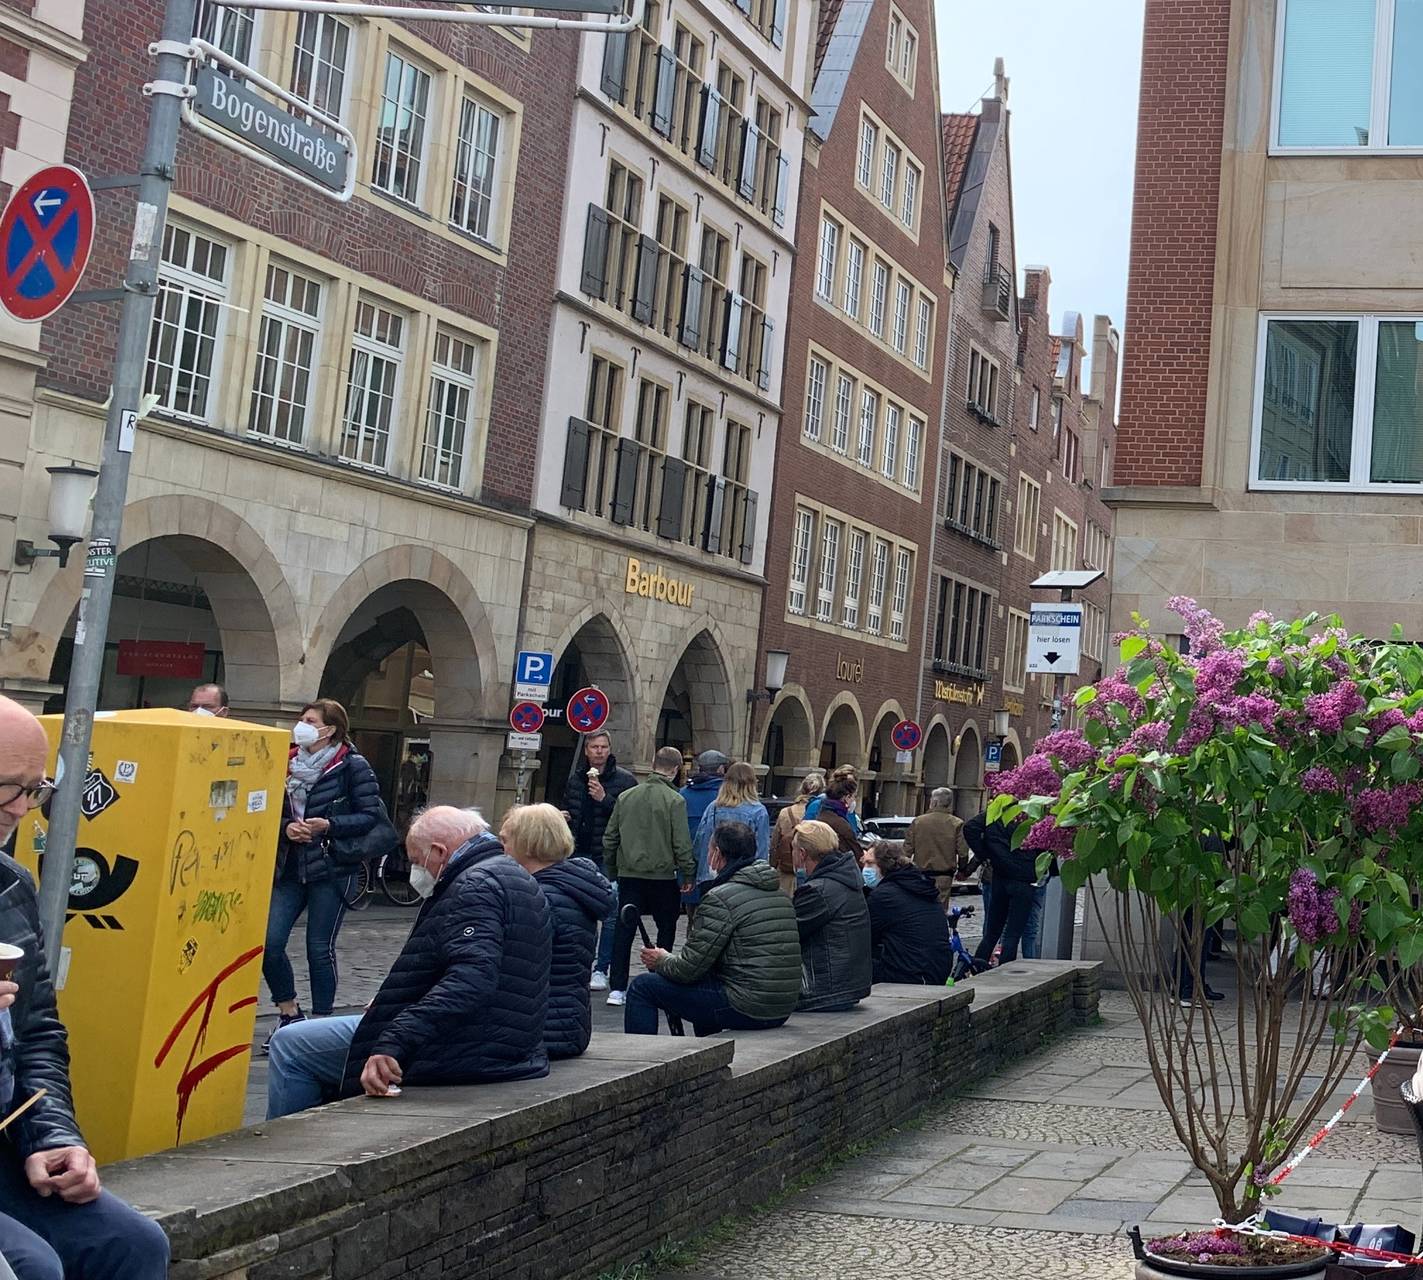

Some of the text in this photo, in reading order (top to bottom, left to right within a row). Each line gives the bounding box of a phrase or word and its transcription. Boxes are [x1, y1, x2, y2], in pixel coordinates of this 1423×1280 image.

[211, 76, 337, 173] Bogenstraße
[625, 557, 695, 608] Barbour
[1031, 614, 1080, 624] PARKSCHEIN
[87, 784, 102, 811] 27
